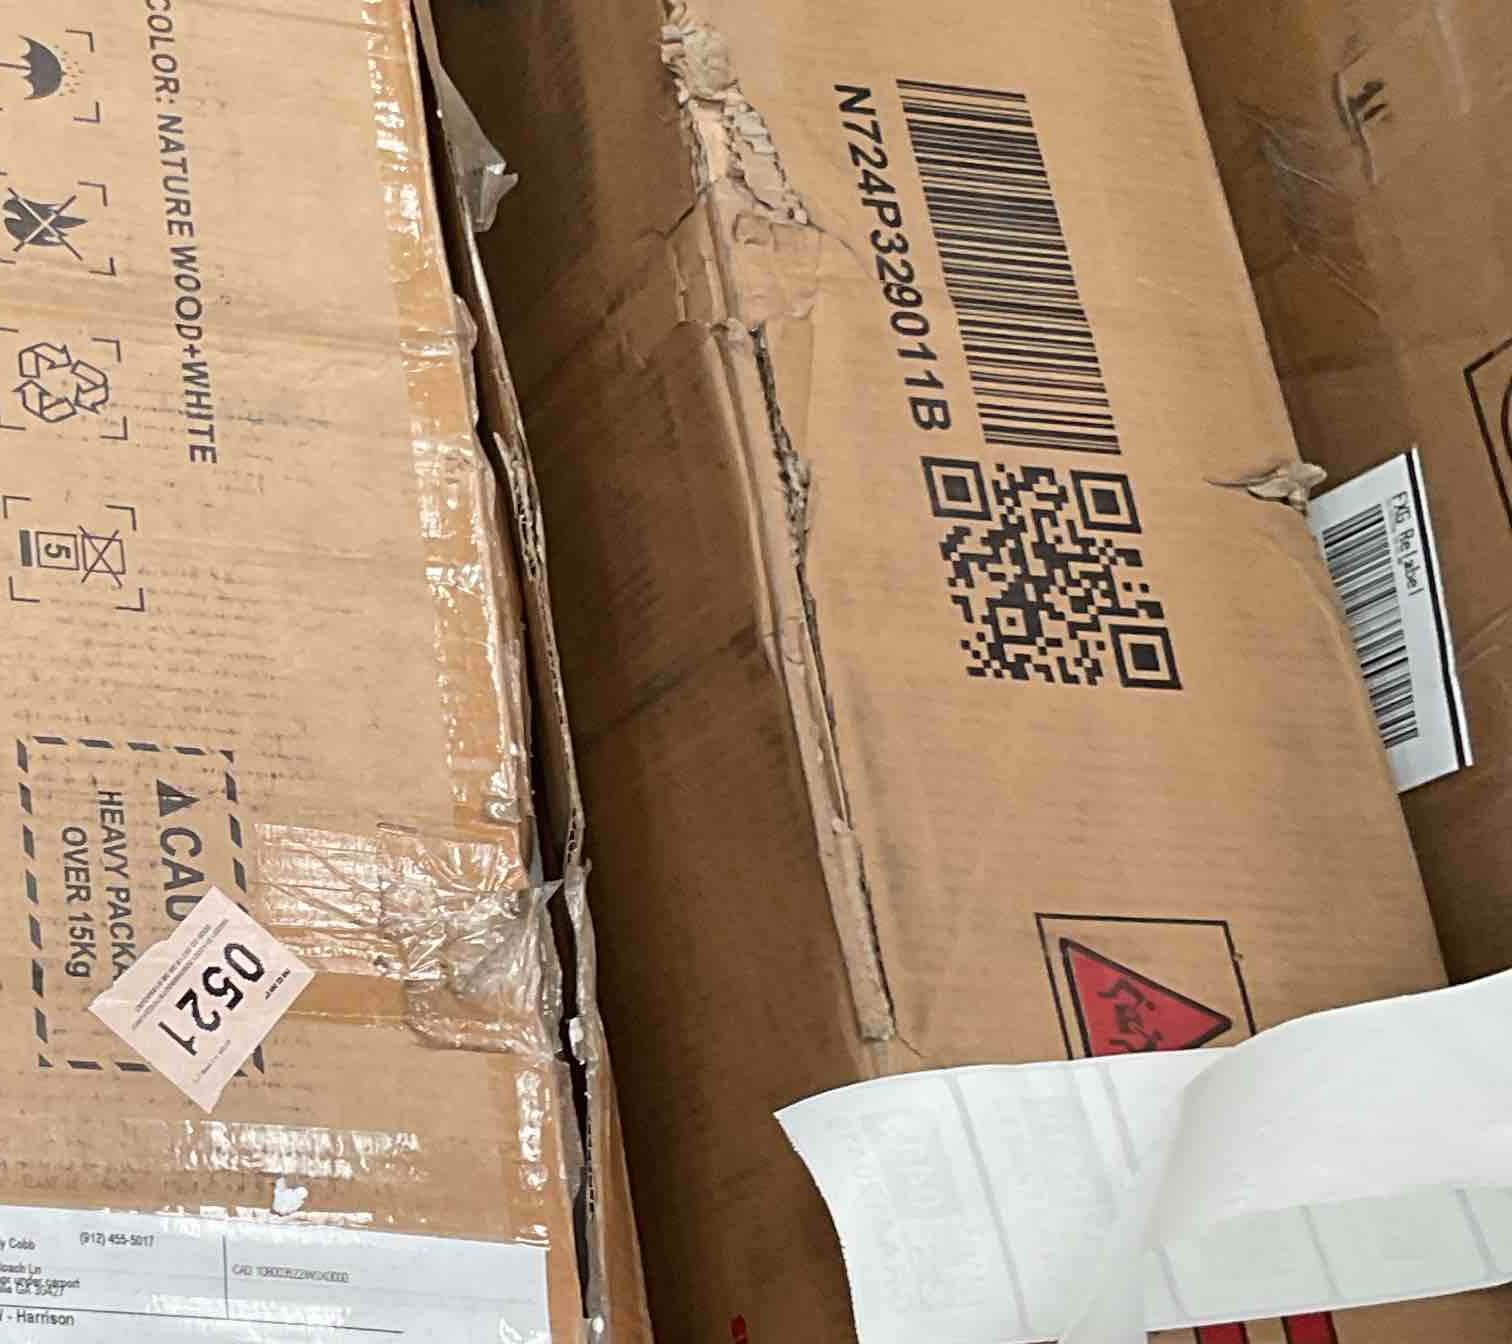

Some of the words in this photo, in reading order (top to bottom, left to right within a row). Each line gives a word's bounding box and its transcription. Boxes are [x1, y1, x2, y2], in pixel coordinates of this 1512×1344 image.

[157, 113, 194, 238] NATURE
[833, 83, 952, 433] N724P329011B
[168, 246, 219, 464] WOOD+WHITE
[44, 542, 72, 561] 5
[61, 825, 92, 904] OVER
[98, 790, 131, 881] HEAVY
[66, 913, 99, 978] 15Kg
[105, 886, 138, 983] PACKA
[158, 941, 266, 1057] 0521
[16, 1308, 74, 1326] Harrison
